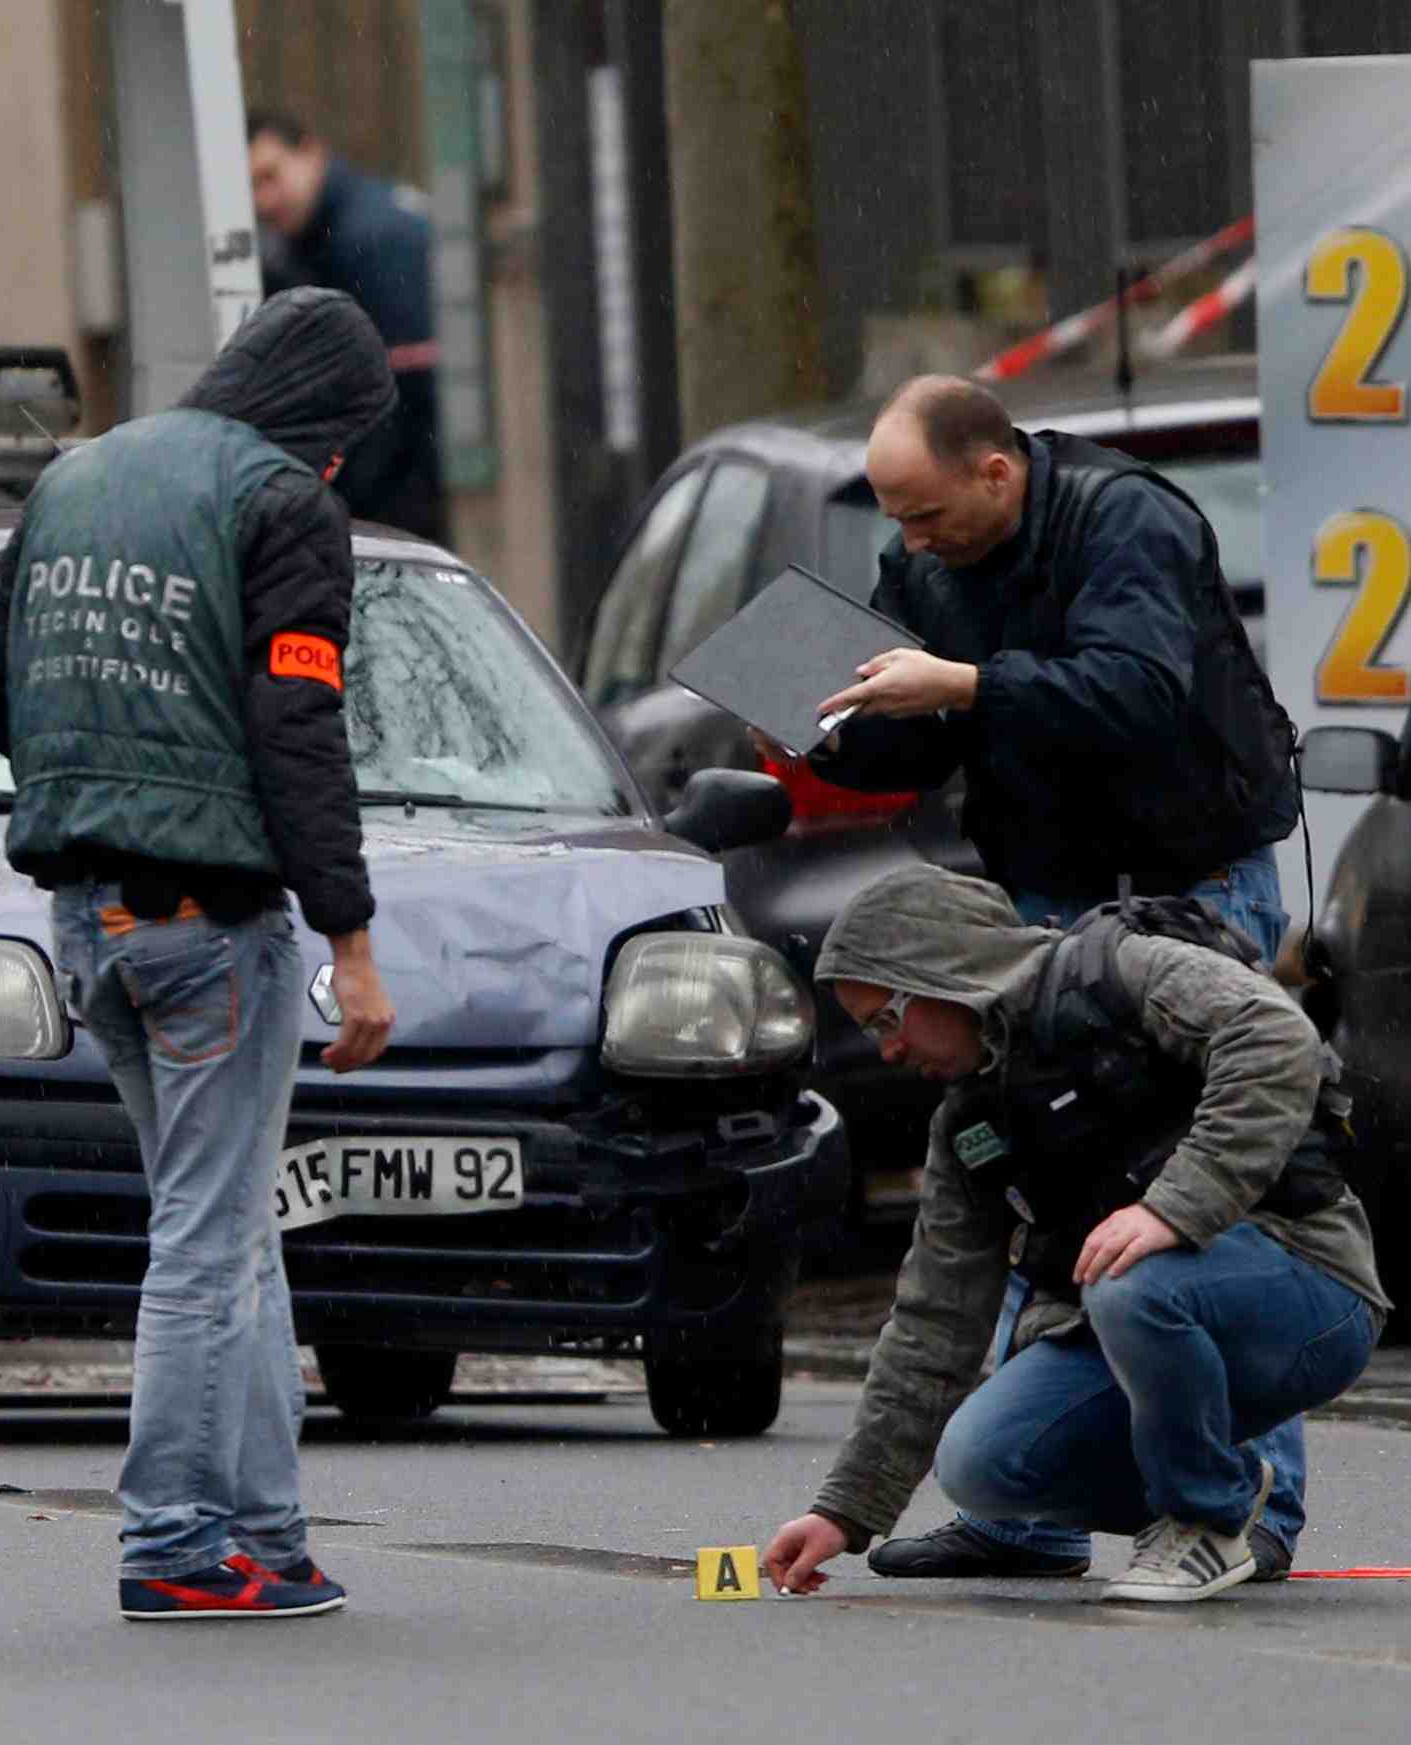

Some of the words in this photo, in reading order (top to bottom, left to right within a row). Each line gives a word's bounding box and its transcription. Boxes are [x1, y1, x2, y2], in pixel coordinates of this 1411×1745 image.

[1304, 224, 1407, 424] 2
[26, 555, 197, 621] POLICE
[1313, 508, 1410, 704] 2
[25, 610, 190, 655] TECHNQUE
[452, 1147, 517, 1201] 92
[715, 1551, 742, 1593] A
